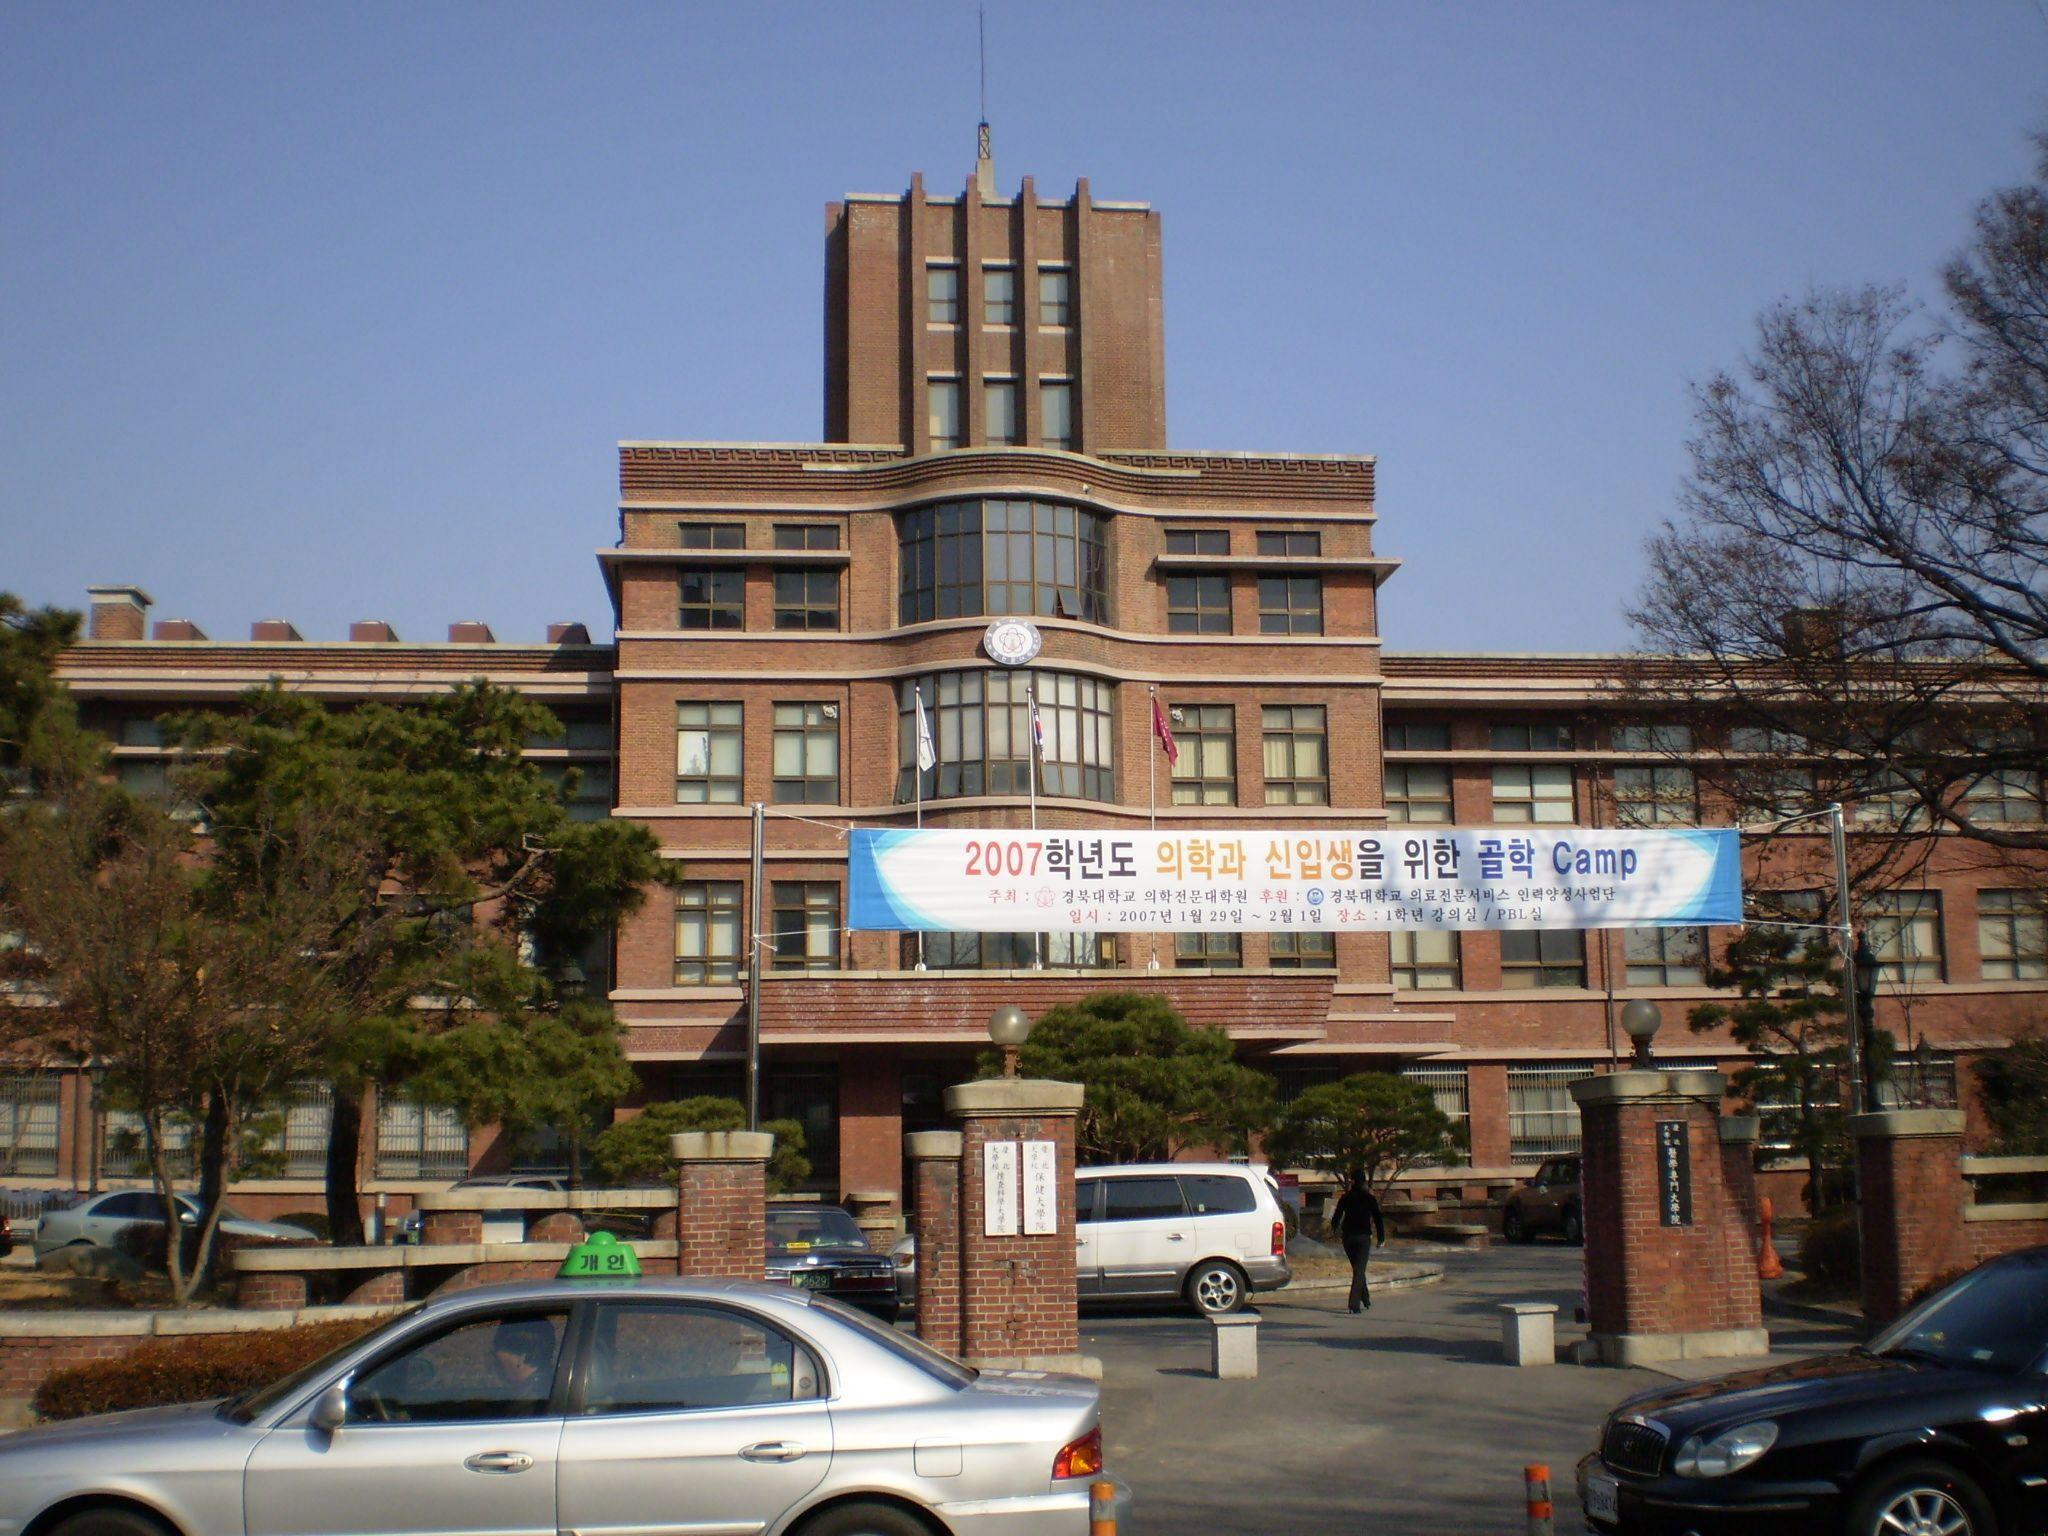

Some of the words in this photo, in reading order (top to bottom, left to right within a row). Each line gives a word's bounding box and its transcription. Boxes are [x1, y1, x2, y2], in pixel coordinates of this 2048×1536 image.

[965, 838, 1137, 880] 2007학년도
[1156, 838, 1247, 880] 의학과
[1265, 838, 1385, 881] 신입생을
[1404, 837, 1461, 880] 위한
[1477, 838, 1536, 880] 골학
[1552, 841, 1638, 881] Camp
[987, 888, 1017, 904] 주최
[1062, 888, 1136, 904] 경북대학교
[1144, 888, 1249, 904] 의학전문대학원
[1259, 888, 1288, 903] 후원
[1330, 888, 1402, 904] 경북대학교
[1410, 887, 1510, 904] 의료전문서비스
[1517, 886, 1616, 903] 인력양성사업단
[1069, 909, 1099, 924] 일시
[1119, 908, 1173, 924] 2007년
[1181, 908, 1203, 924] 1월
[1209, 908, 1243, 924] 29일
[1269, 908, 1293, 924] 2월
[1301, 908, 1322, 924] 1일
[1336, 908, 1367, 924] 장소
[1386, 908, 1424, 924] 1학년
[1431, 908, 1477, 923] 강의실
[1497, 907, 1543, 922] PBL실
